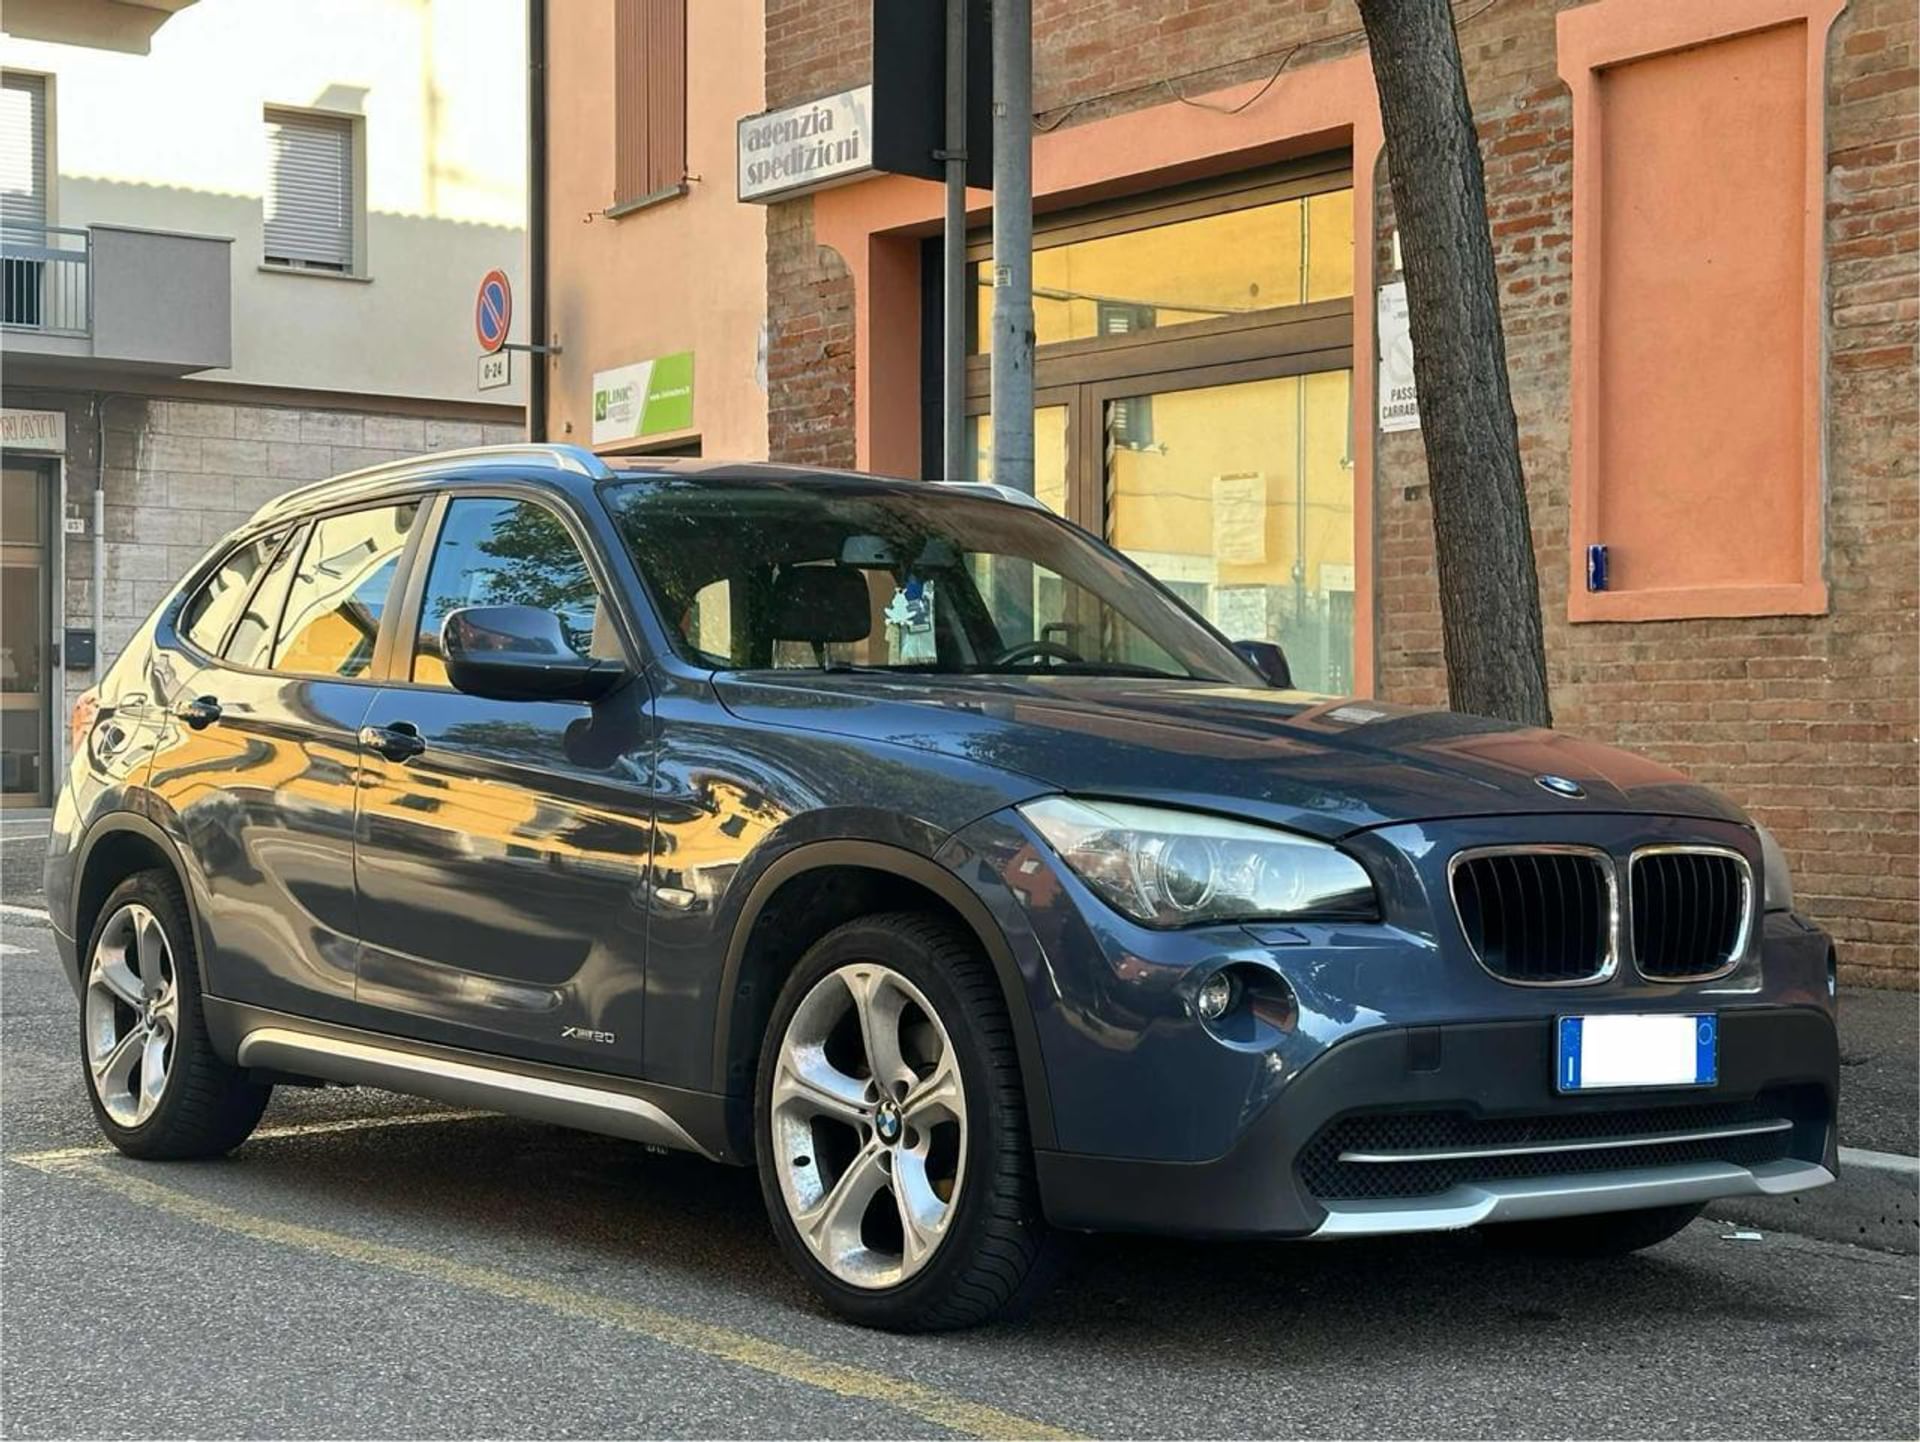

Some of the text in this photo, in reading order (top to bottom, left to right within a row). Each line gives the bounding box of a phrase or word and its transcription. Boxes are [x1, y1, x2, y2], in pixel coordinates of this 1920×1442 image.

[747, 105, 833, 152] agenzia
[746, 130, 859, 186] spedizioni
[484, 361, 502, 379] 0-24
